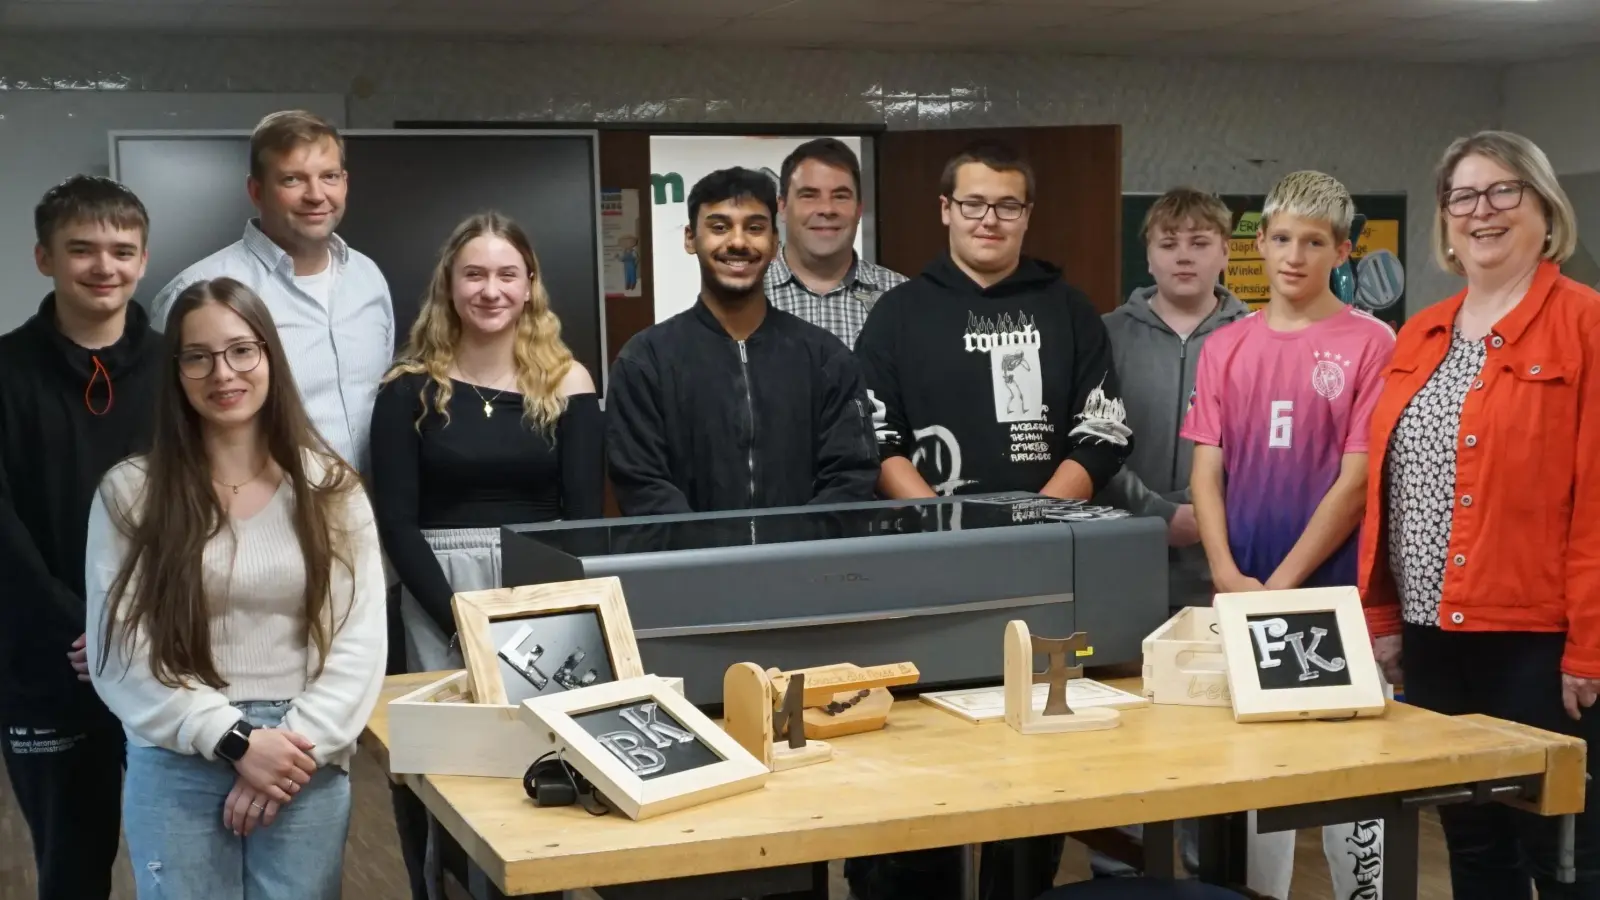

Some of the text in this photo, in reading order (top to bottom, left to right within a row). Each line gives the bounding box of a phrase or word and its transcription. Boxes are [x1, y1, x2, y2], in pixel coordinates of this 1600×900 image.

[1228, 264, 1263, 276] Winkel
[1269, 400, 1293, 448] 6
[1010, 433, 1024, 442] THE
